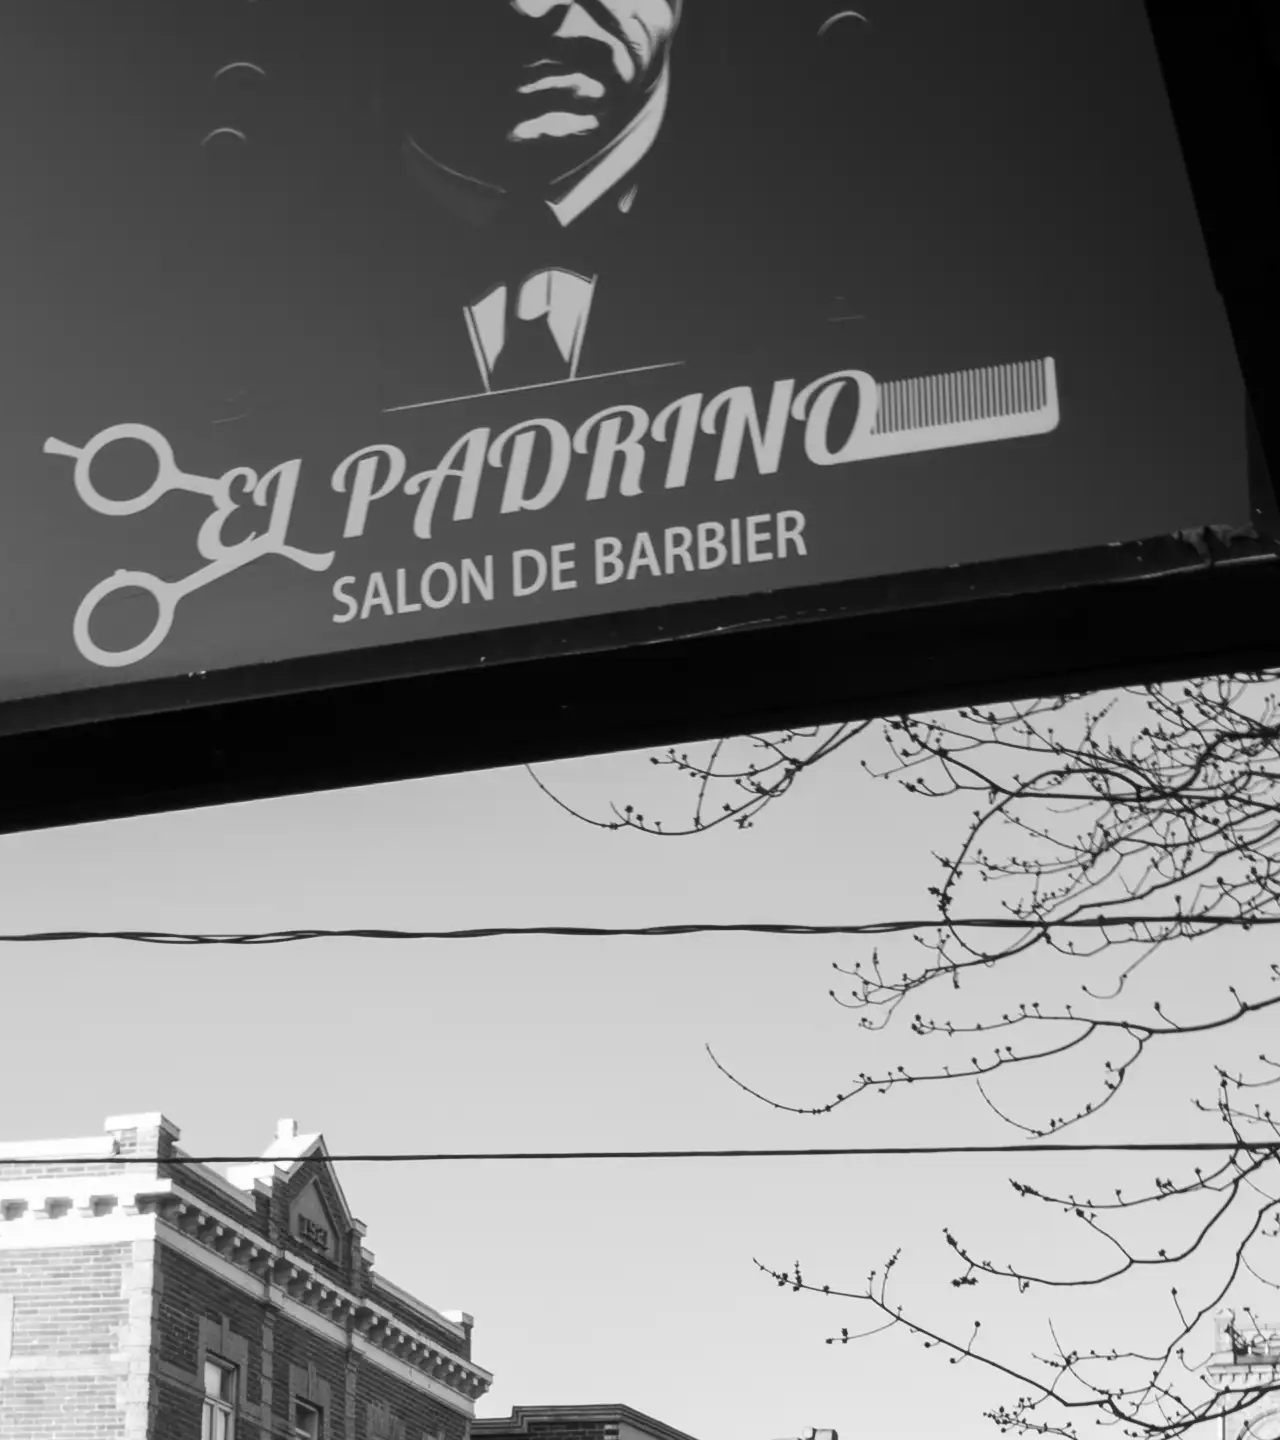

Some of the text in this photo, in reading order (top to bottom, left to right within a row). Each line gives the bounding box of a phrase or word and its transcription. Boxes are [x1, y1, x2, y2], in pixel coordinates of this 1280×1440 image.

[196, 369, 878, 572] EL PADRINO
[331, 509, 809, 624] SALON DE BARBIER
